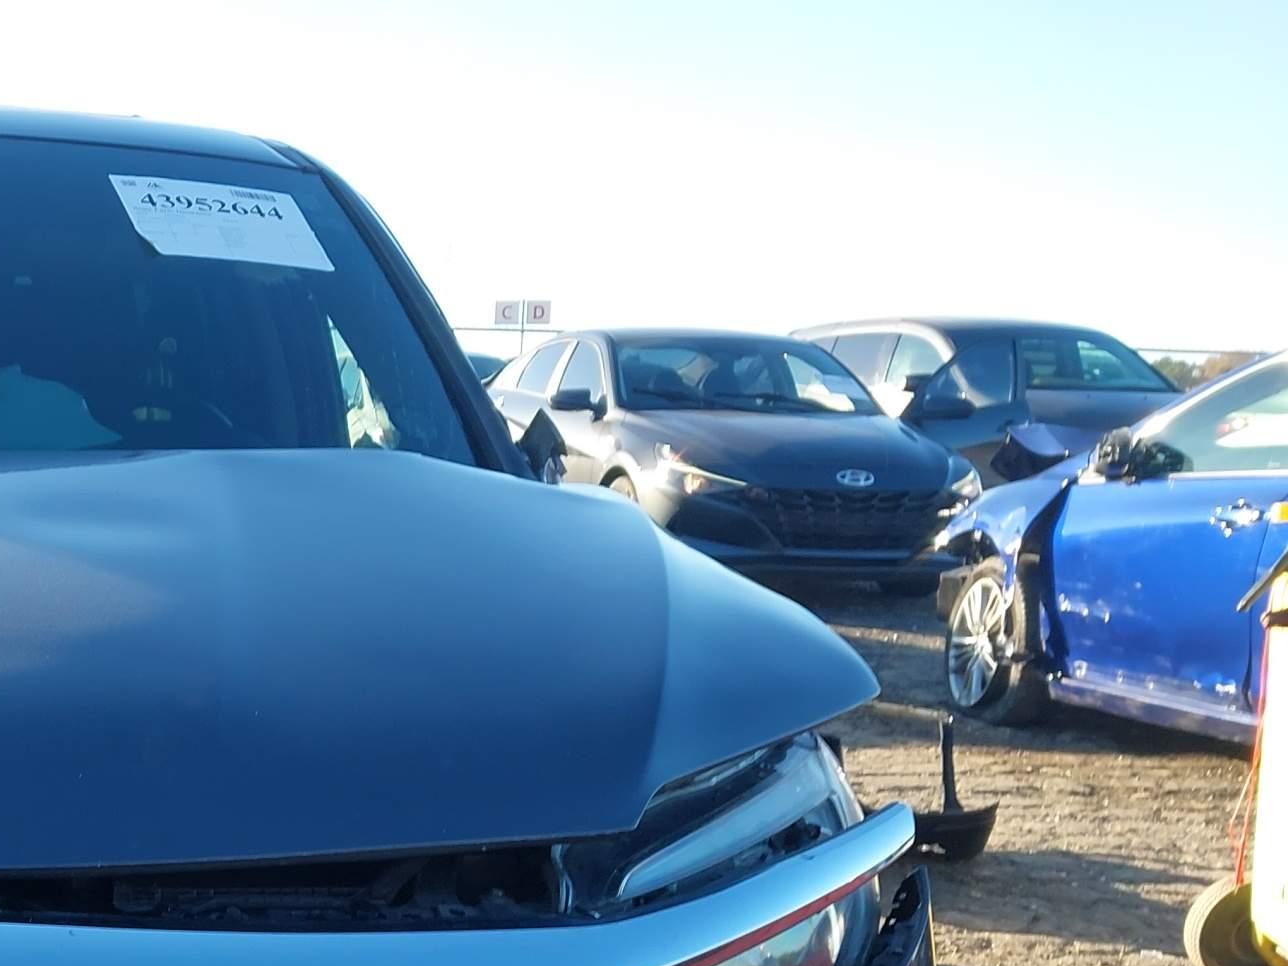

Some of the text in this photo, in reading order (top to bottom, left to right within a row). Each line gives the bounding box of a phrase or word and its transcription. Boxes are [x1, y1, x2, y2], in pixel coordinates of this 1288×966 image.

[140, 192, 284, 220] 43952644
[502, 305, 513, 320] C
[533, 305, 545, 320] D
